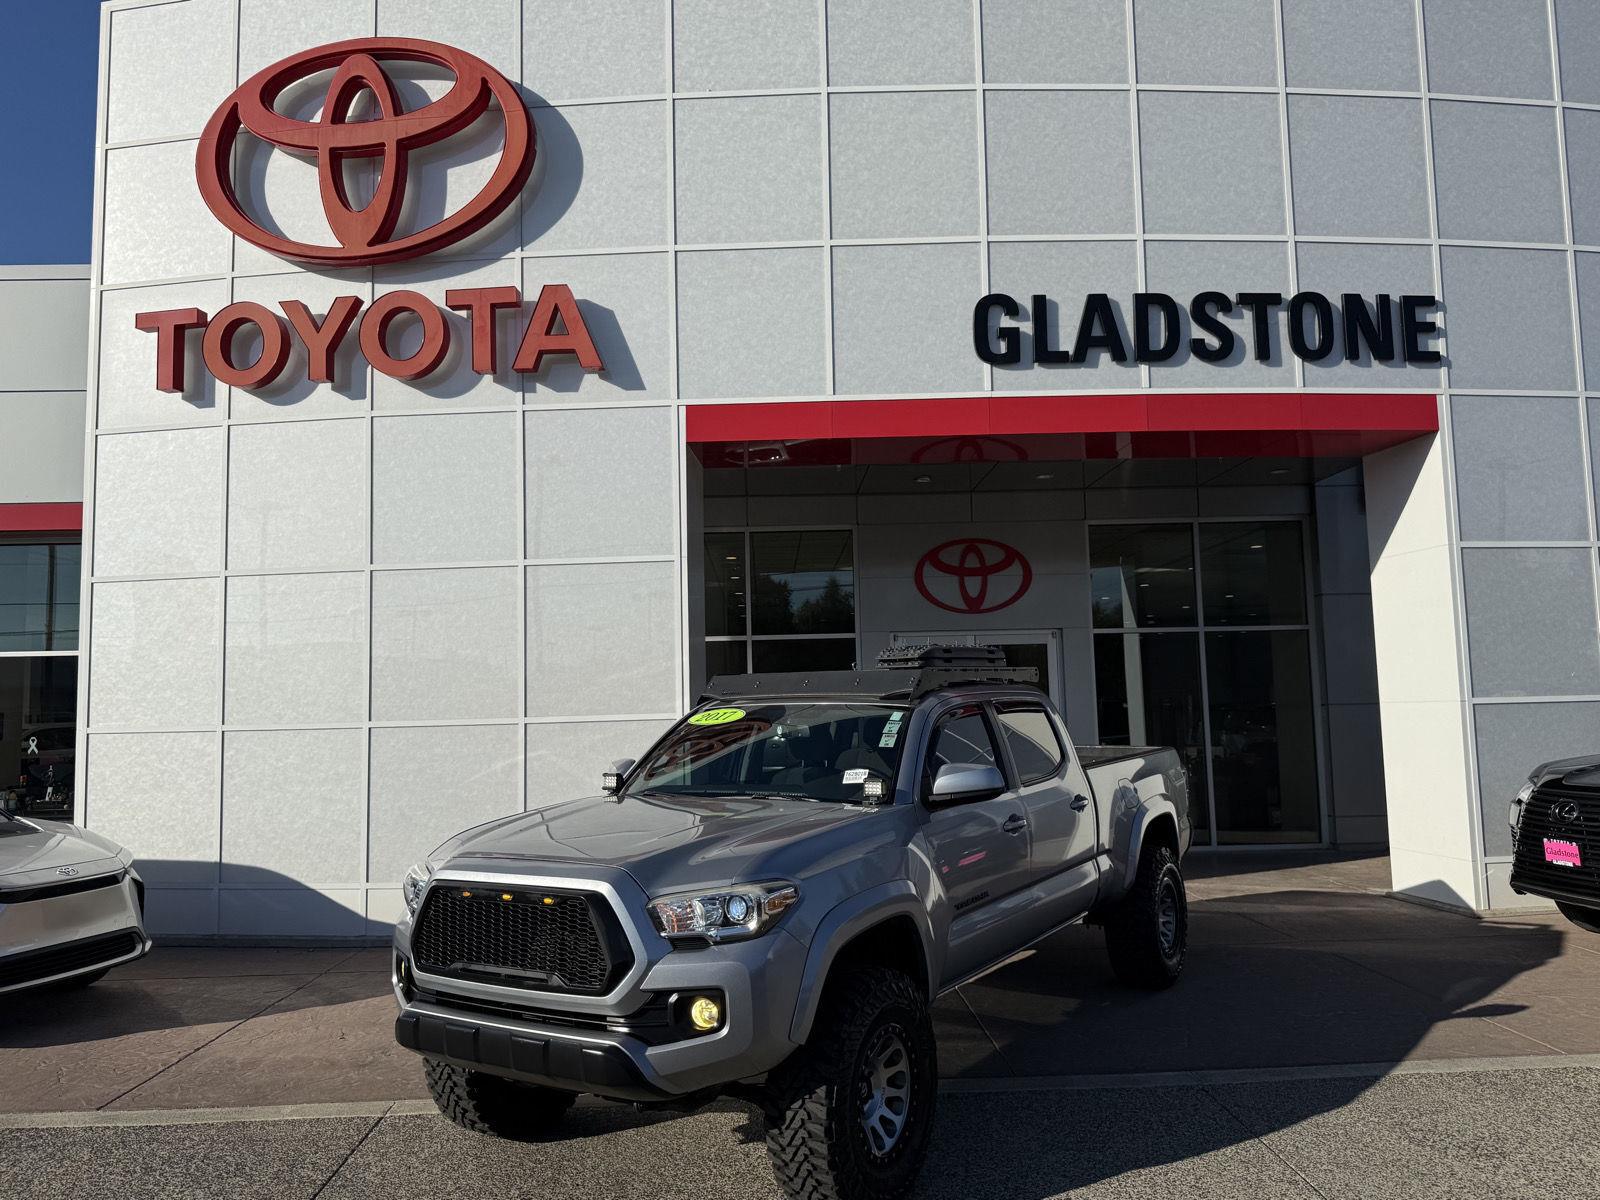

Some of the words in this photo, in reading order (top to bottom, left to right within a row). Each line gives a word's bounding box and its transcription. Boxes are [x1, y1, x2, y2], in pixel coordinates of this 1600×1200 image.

[135, 283, 605, 393] TOYOTA
[973, 291, 1441, 364] GLADSTONE
[696, 710, 738, 721] 2017
[1546, 847, 1578, 858] Gladstone
